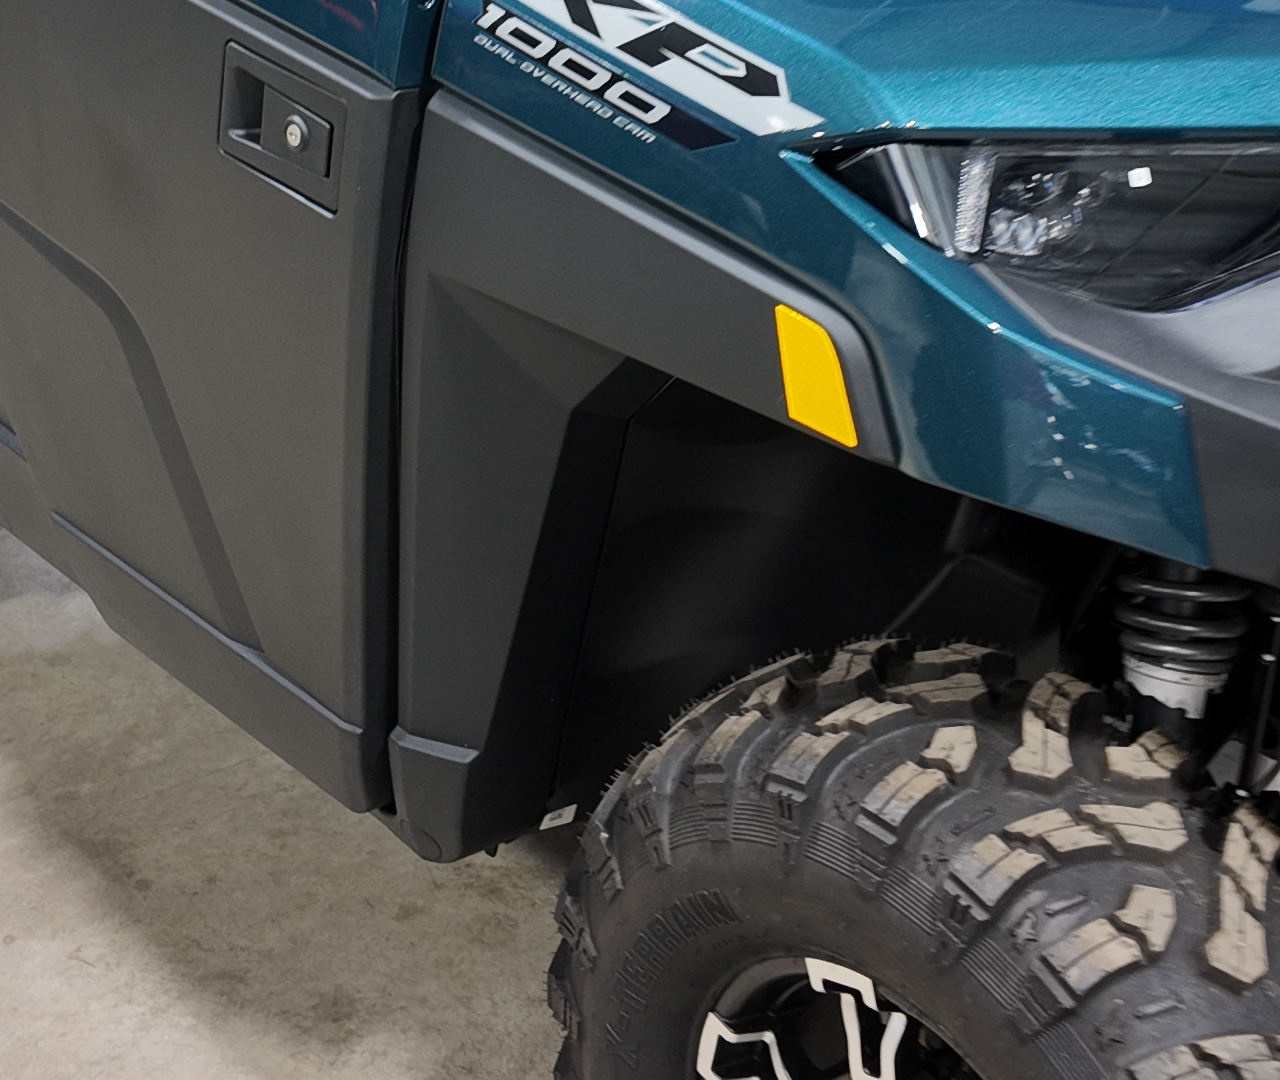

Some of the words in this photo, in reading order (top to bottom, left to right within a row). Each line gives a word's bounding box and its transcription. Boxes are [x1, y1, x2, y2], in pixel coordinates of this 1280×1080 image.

[472, 34, 517, 65] DUAL
[519, 60, 614, 120] OVERHEAD
[612, 114, 658, 144] CAM
[473, 0, 673, 126] 1000
